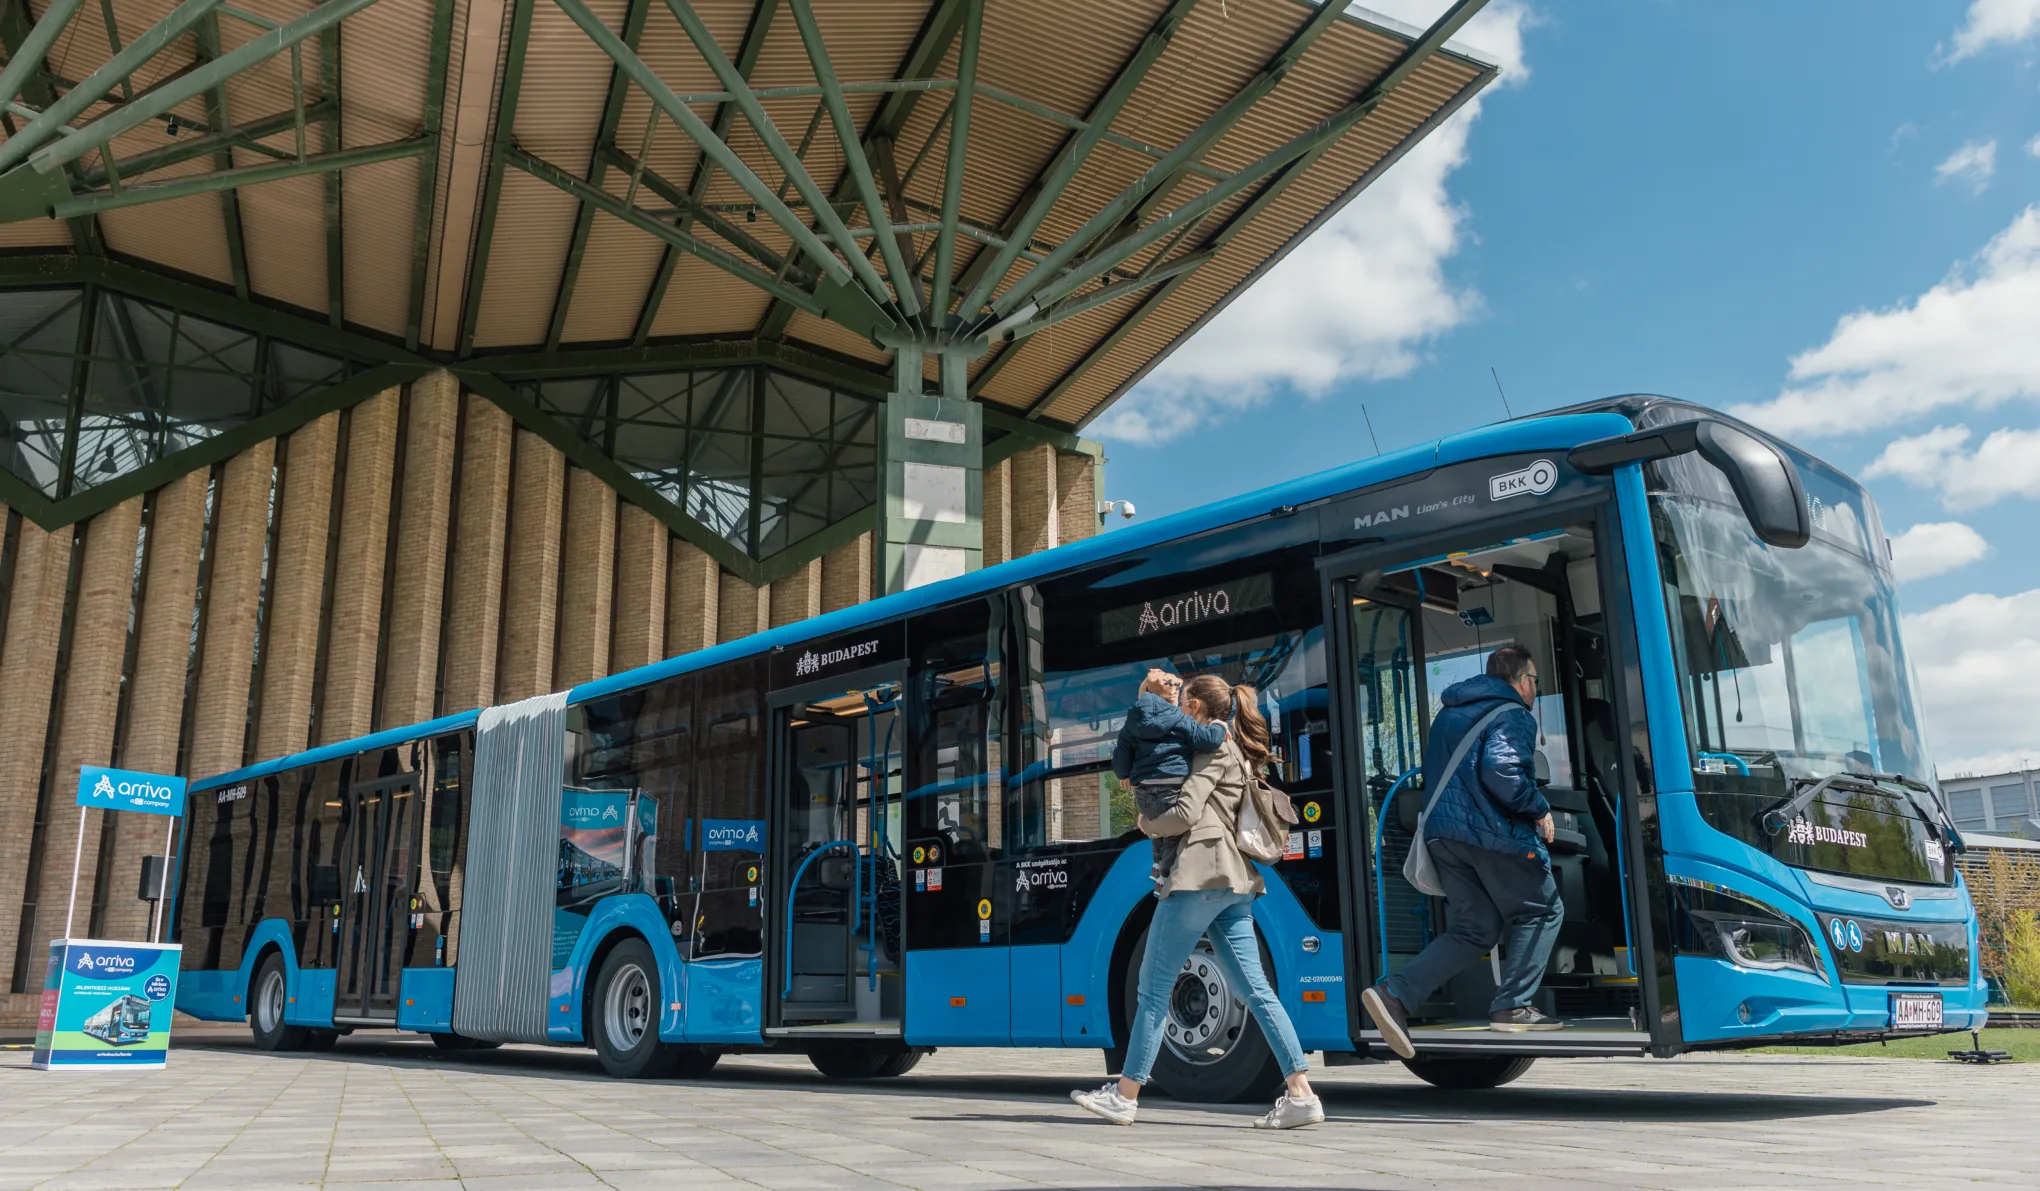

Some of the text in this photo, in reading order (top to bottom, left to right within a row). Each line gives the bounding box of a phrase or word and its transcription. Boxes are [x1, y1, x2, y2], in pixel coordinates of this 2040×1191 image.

[1499, 475, 1526, 492] BKK
[1354, 493, 1475, 530] MAN Lion's City
[1160, 590, 1229, 627] arriva
[821, 640, 879, 666] BUDAPEST
[118, 781, 171, 800] arriva
[217, 786, 247, 804] AA-MH-609
[143, 800, 169, 808] company
[1815, 826, 1867, 848] BUDAPEST
[1031, 869, 1067, 885] arriva
[1884, 931, 1935, 956] MAN
[96, 955, 134, 967] arriva
